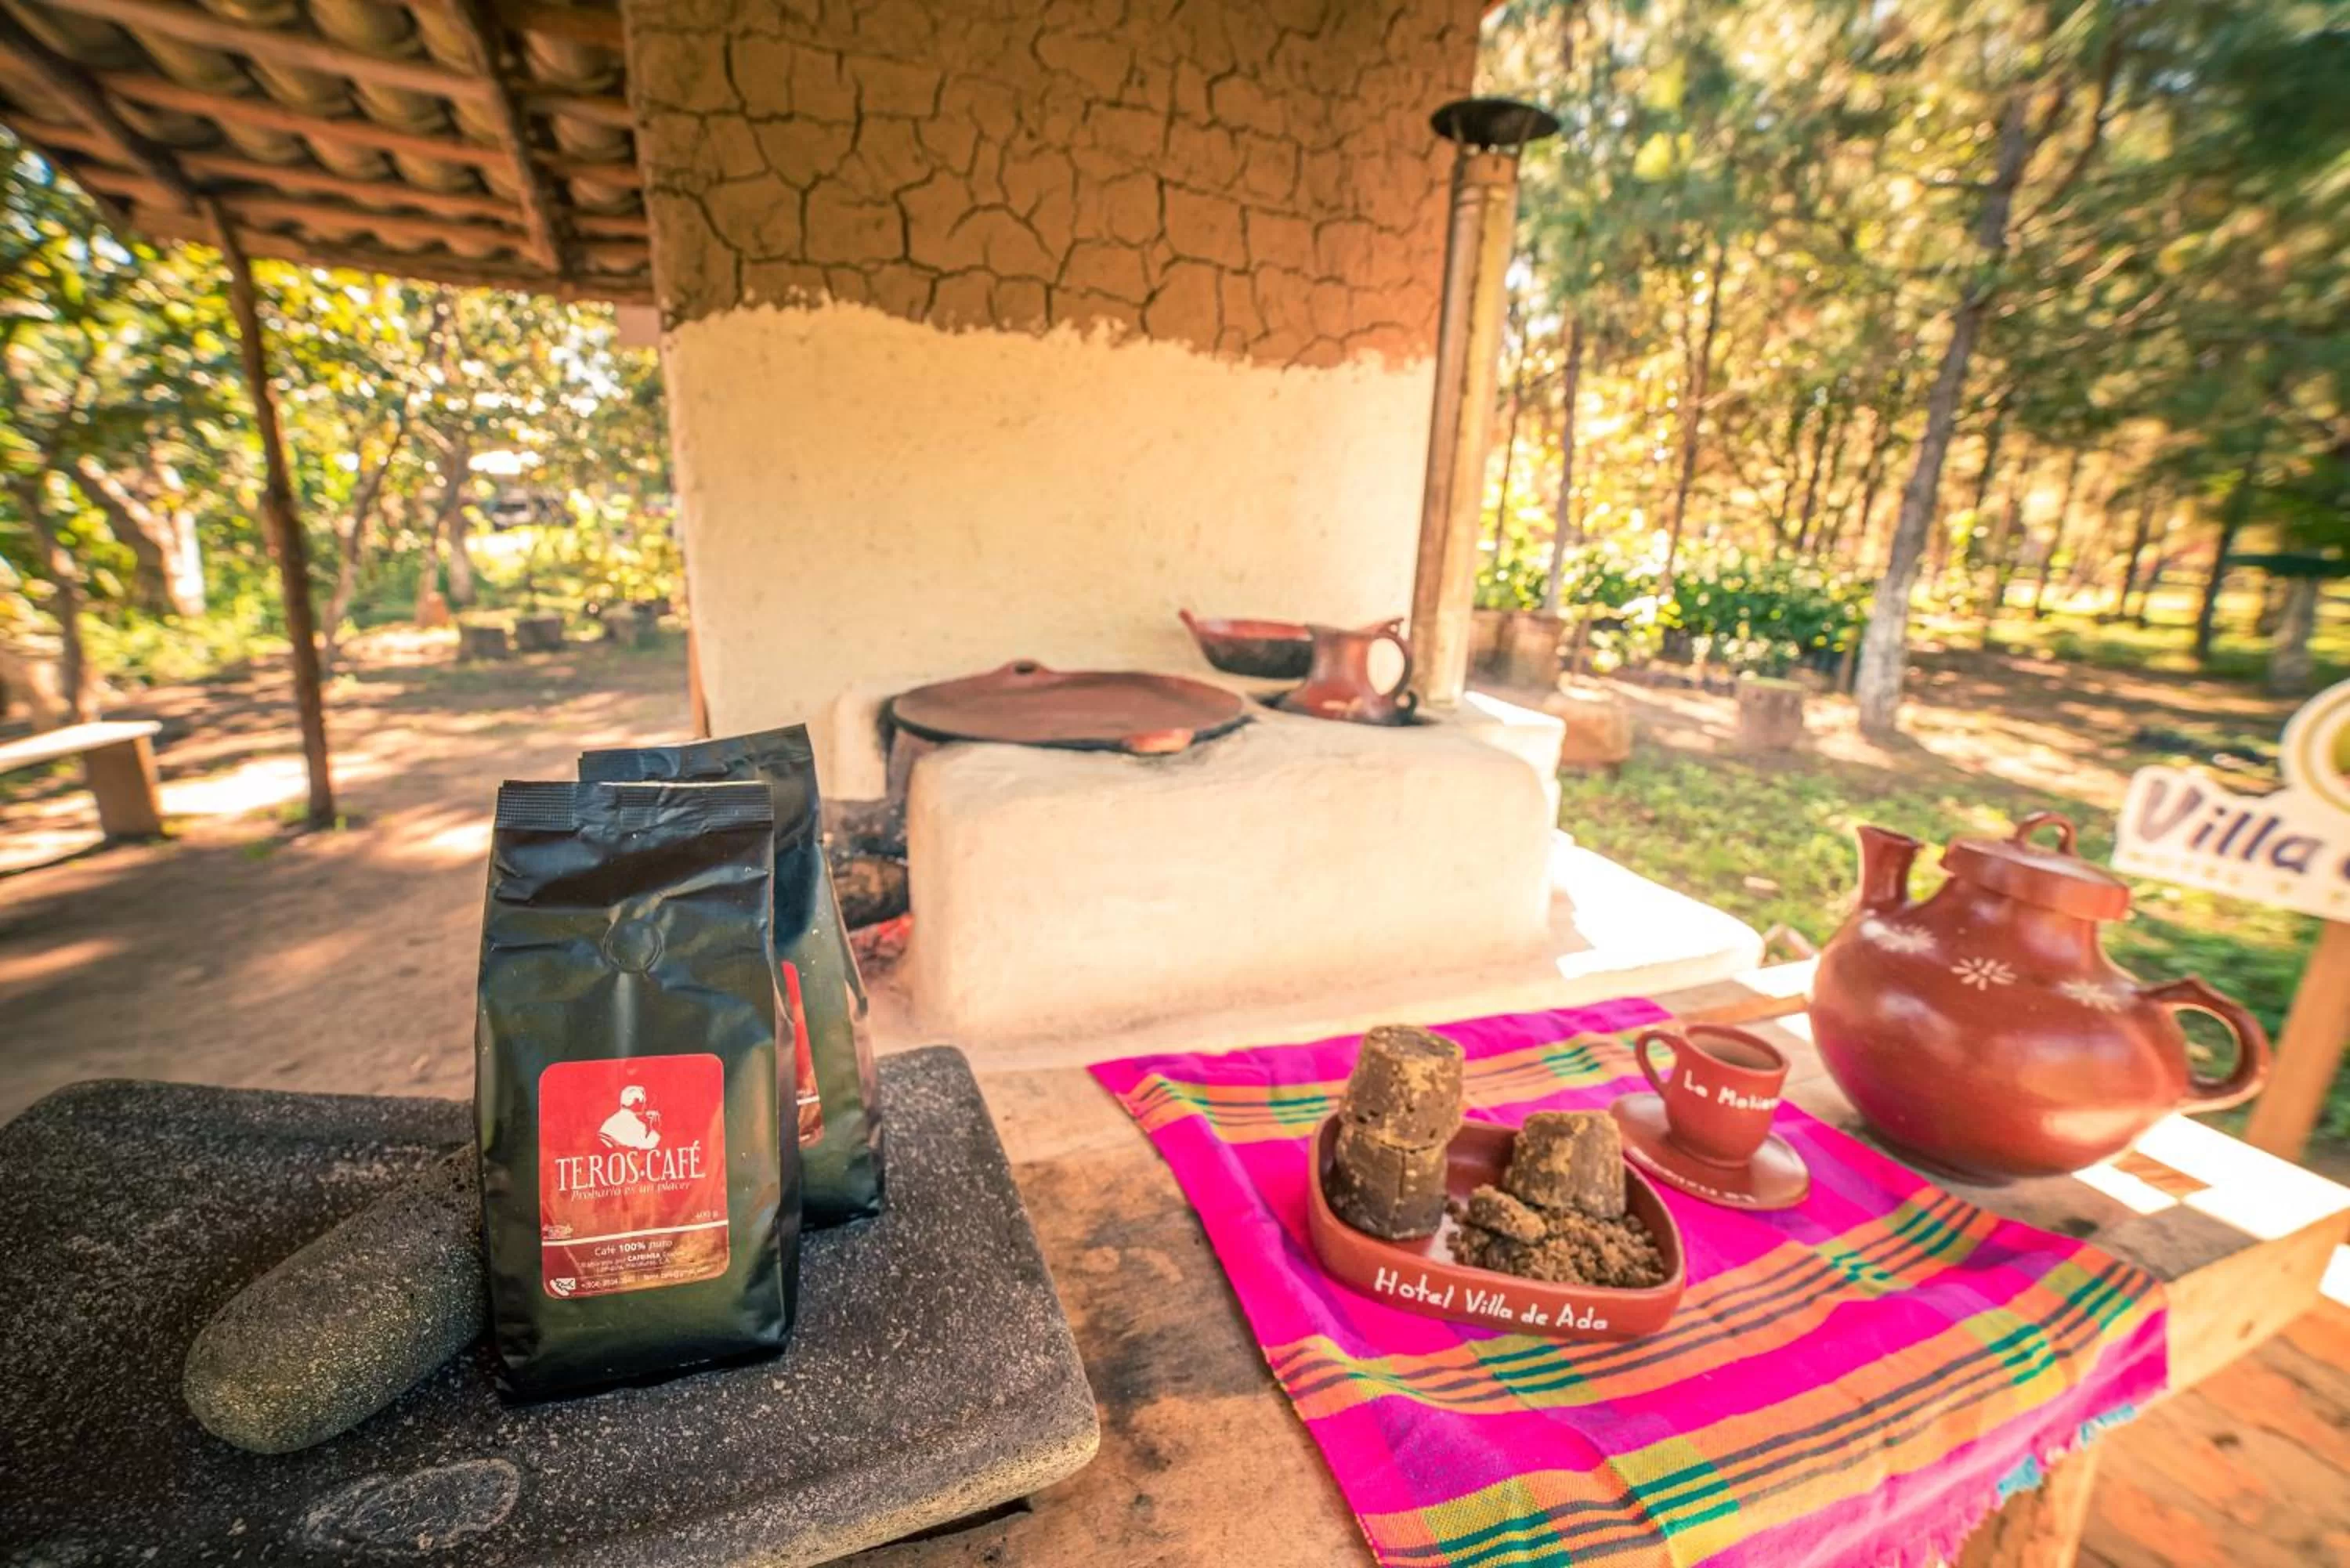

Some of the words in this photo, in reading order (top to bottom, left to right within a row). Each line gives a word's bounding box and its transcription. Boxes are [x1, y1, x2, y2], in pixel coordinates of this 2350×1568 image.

[2136, 779, 2326, 875] Villa
[595, 1245, 616, 1257] Café
[619, 1241, 646, 1253] 100%
[648, 1239, 672, 1252] puro
[1373, 1266, 1455, 1309] Hotel
[1464, 1288, 1513, 1321] Villa
[1520, 1302, 1549, 1327] de
[1555, 1302, 1609, 1331] Ada
